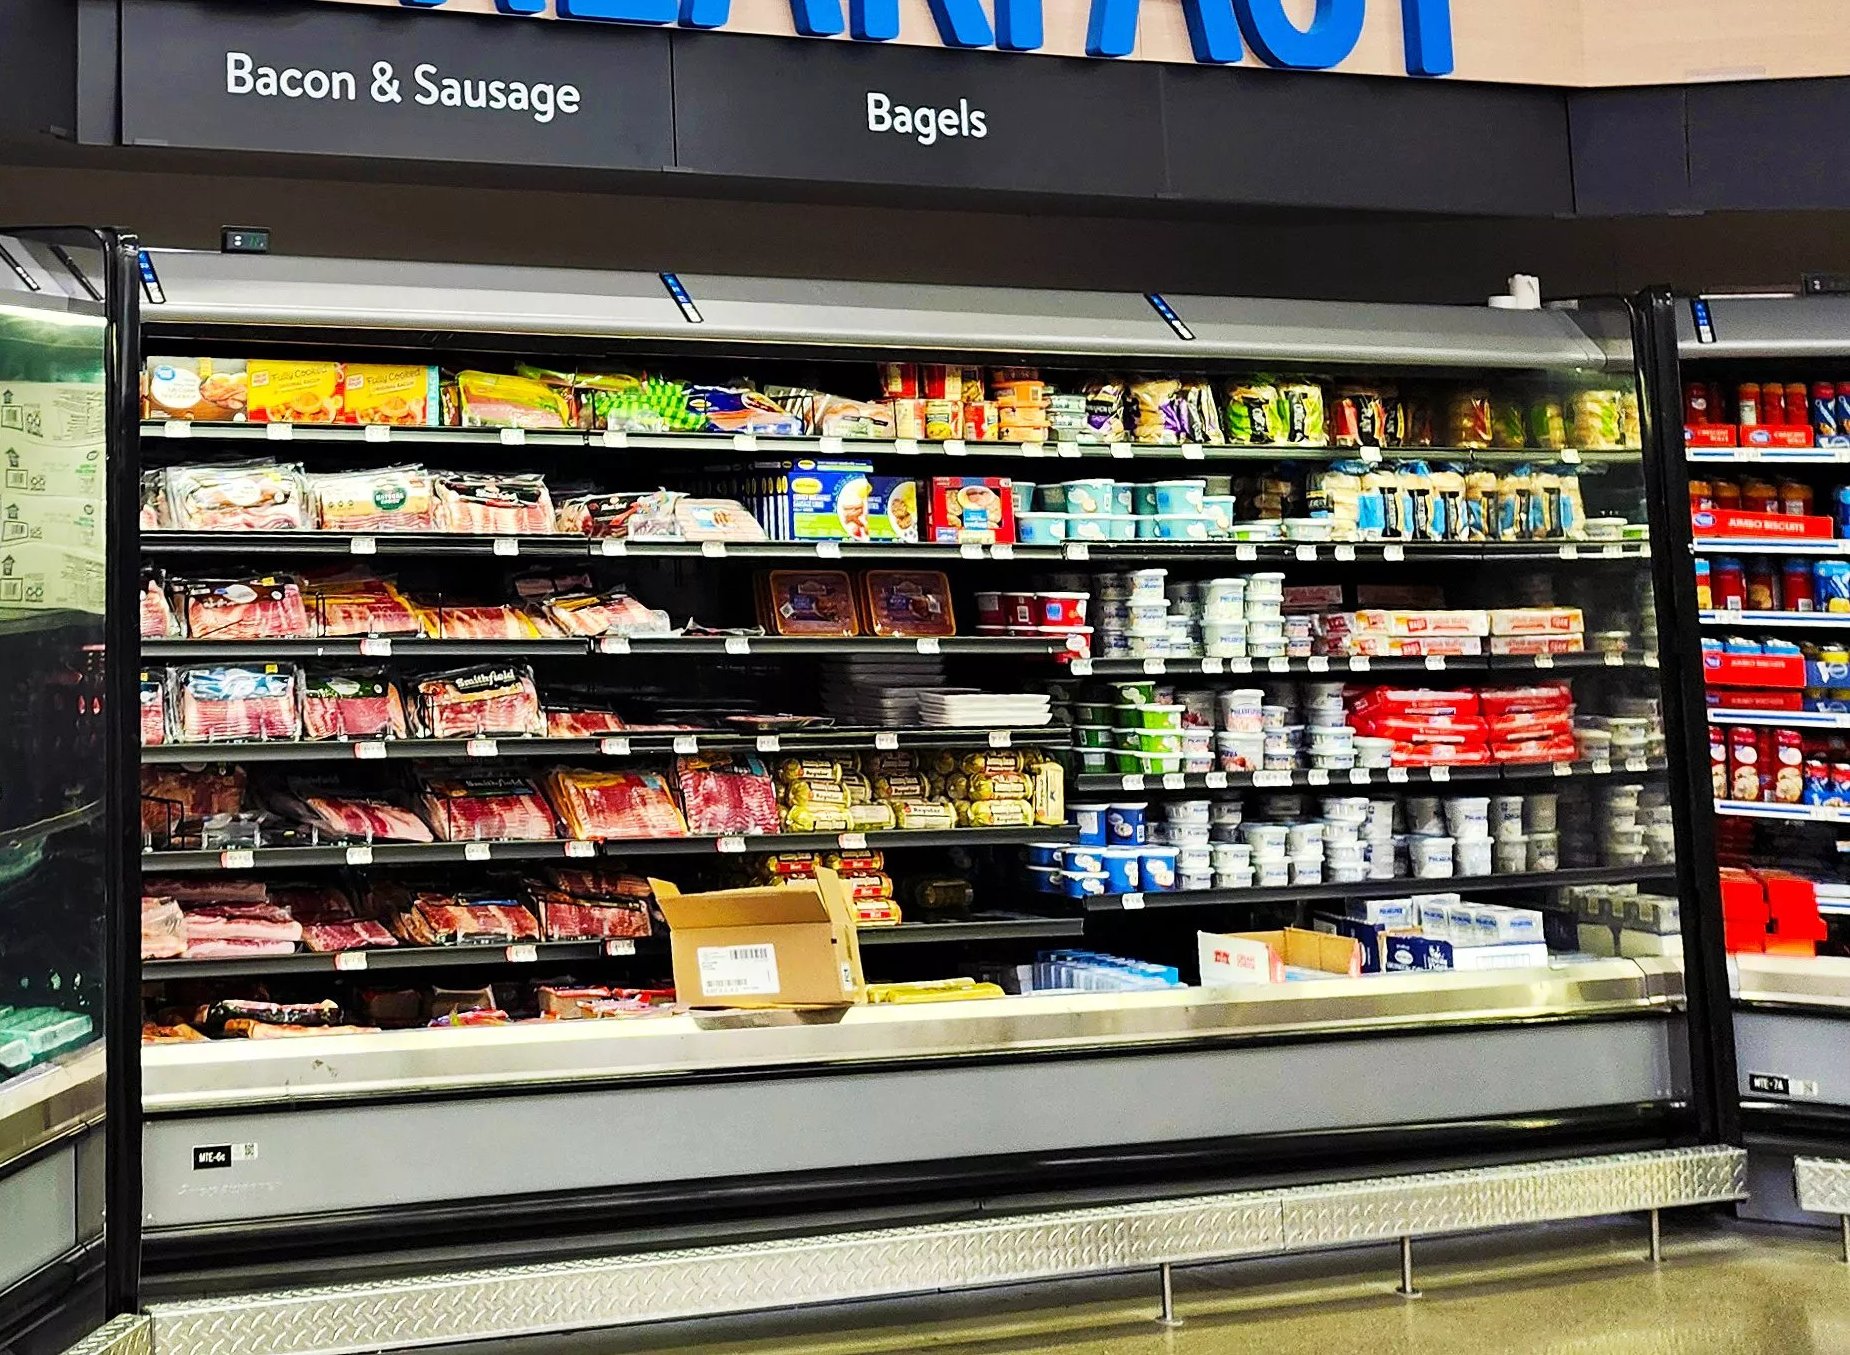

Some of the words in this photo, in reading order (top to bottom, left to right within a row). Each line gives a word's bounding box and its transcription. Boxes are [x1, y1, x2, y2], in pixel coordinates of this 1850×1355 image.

[225, 51, 357, 101] Bacon
[369, 60, 402, 104] &
[413, 64, 581, 124] Sausage
[866, 92, 988, 146] Bagels
[294, 363, 329, 379] Cooked
[388, 367, 422, 382] Cooked
[1728, 517, 1763, 528] JUMBO
[1763, 519, 1805, 532] BISCUITS
[455, 669, 516, 689] Smithfield
[913, 806, 941, 814] Regular
